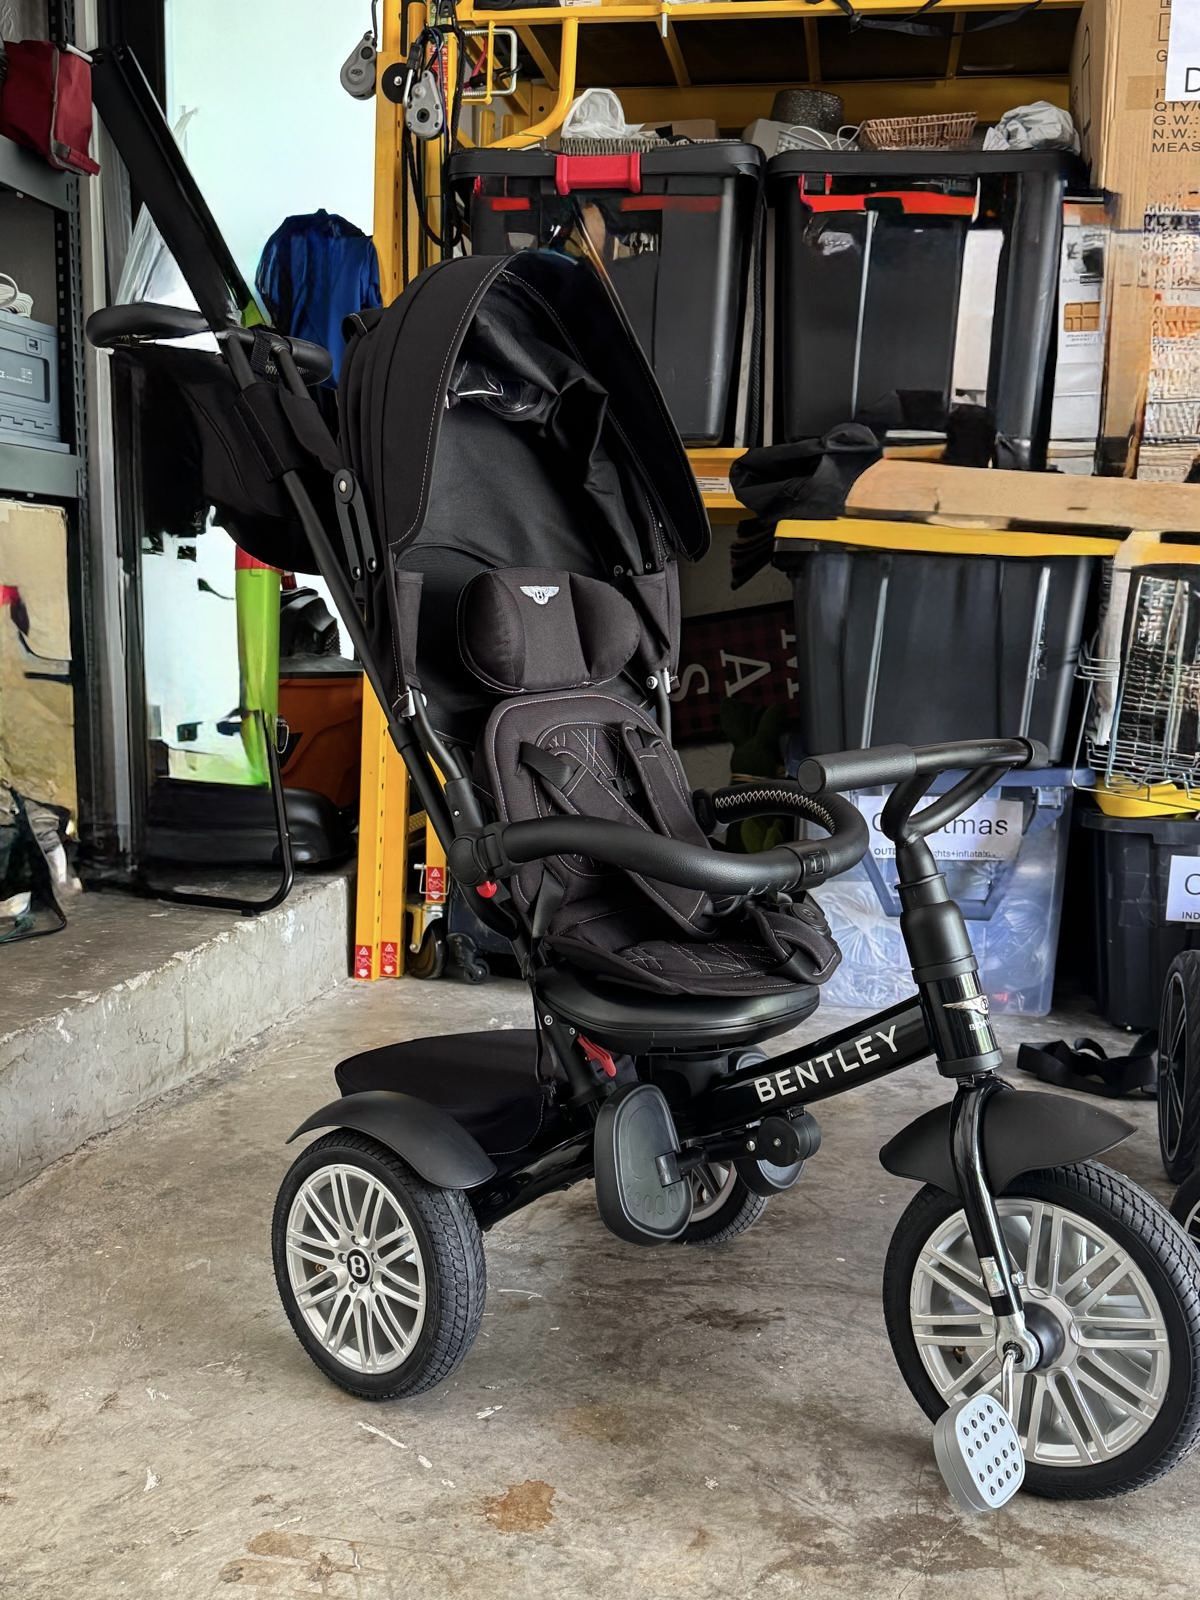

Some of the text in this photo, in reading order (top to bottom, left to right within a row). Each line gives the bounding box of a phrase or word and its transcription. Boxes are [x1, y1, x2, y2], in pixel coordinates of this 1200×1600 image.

[1153, 115, 1199, 126] G.W.:
[1152, 128, 1197, 139] N.W.:
[753, 1024, 899, 1103] BENTLEY
[349, 1254, 368, 1279] B
